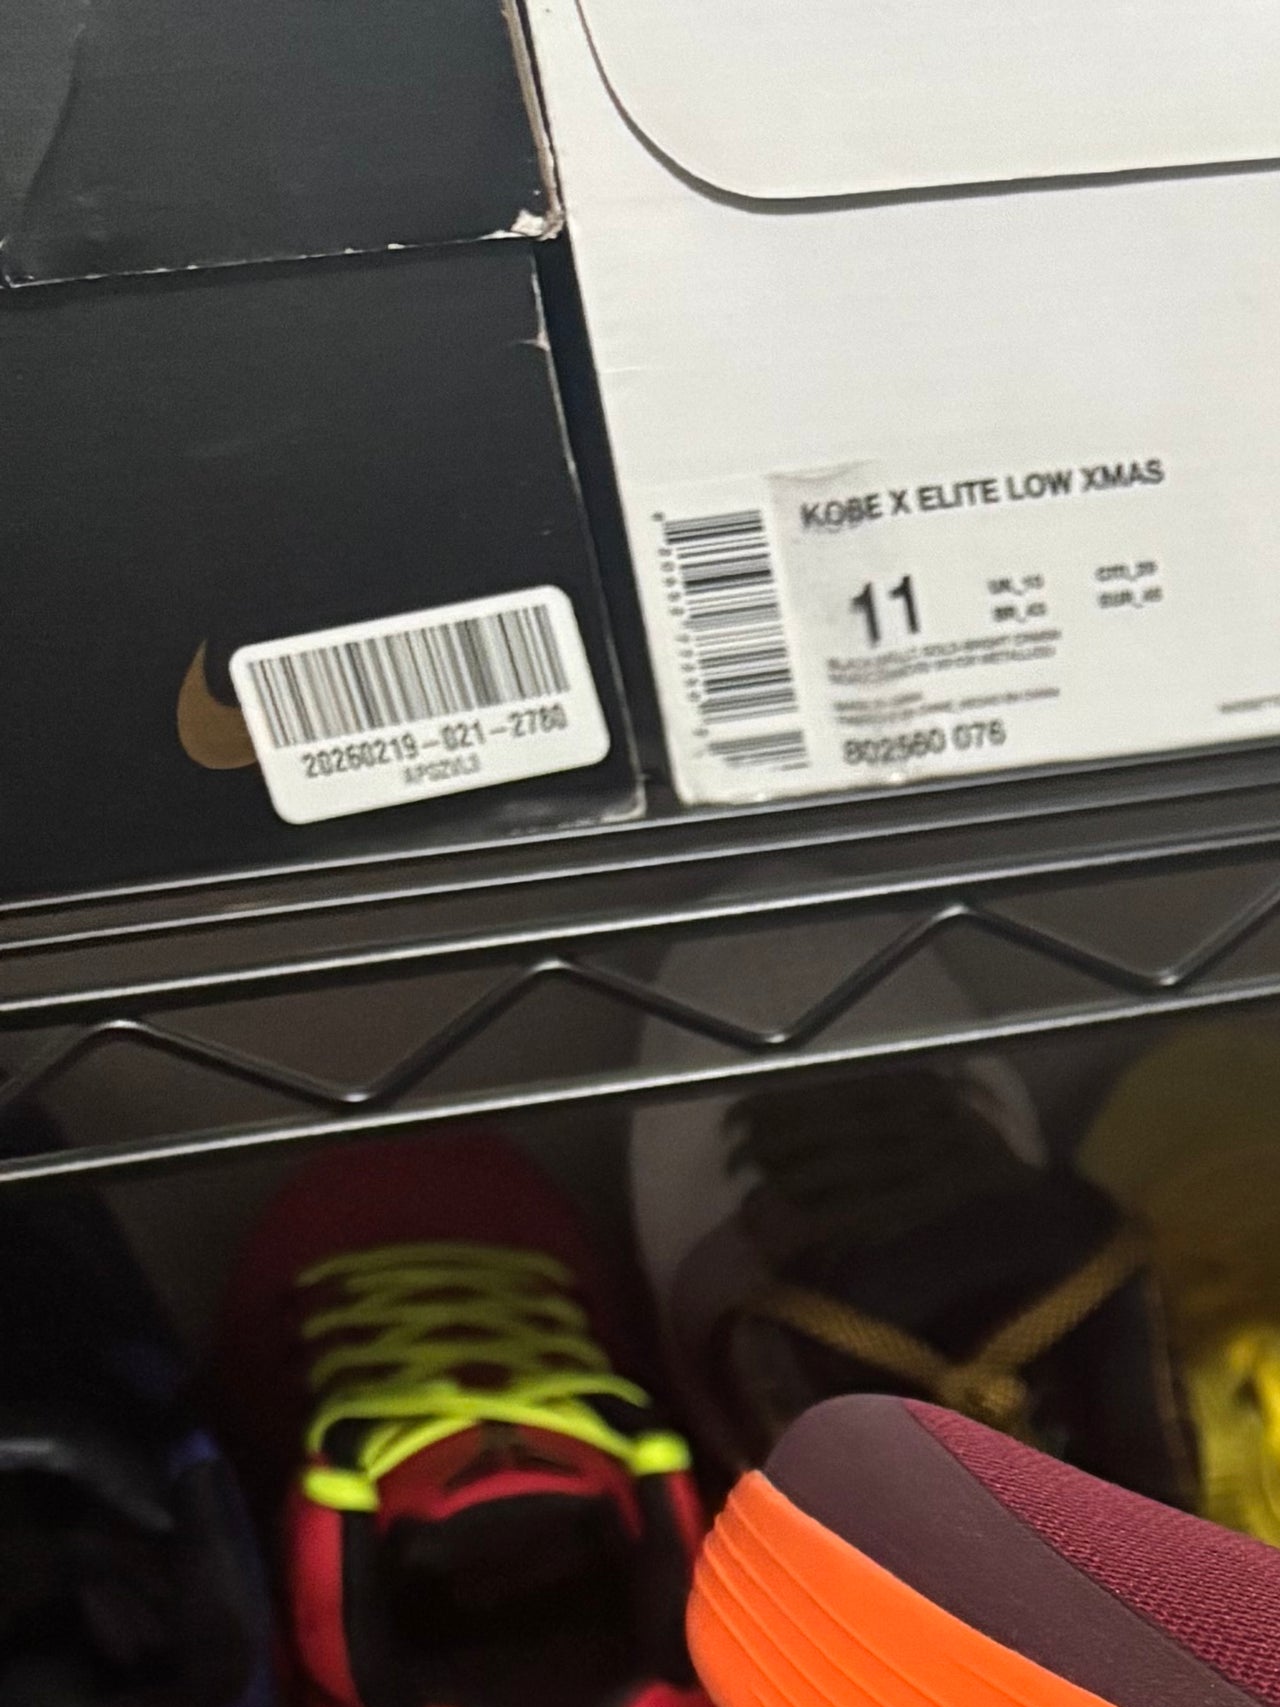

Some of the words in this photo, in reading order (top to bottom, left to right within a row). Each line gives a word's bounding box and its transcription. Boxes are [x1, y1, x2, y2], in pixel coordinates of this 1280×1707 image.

[801, 493, 883, 530] KOBE
[889, 489, 912, 515] X
[916, 478, 1000, 511] ELITE
[1005, 469, 1074, 501] LOW
[1081, 458, 1166, 493] XMAS
[850, 573, 921, 645] 11
